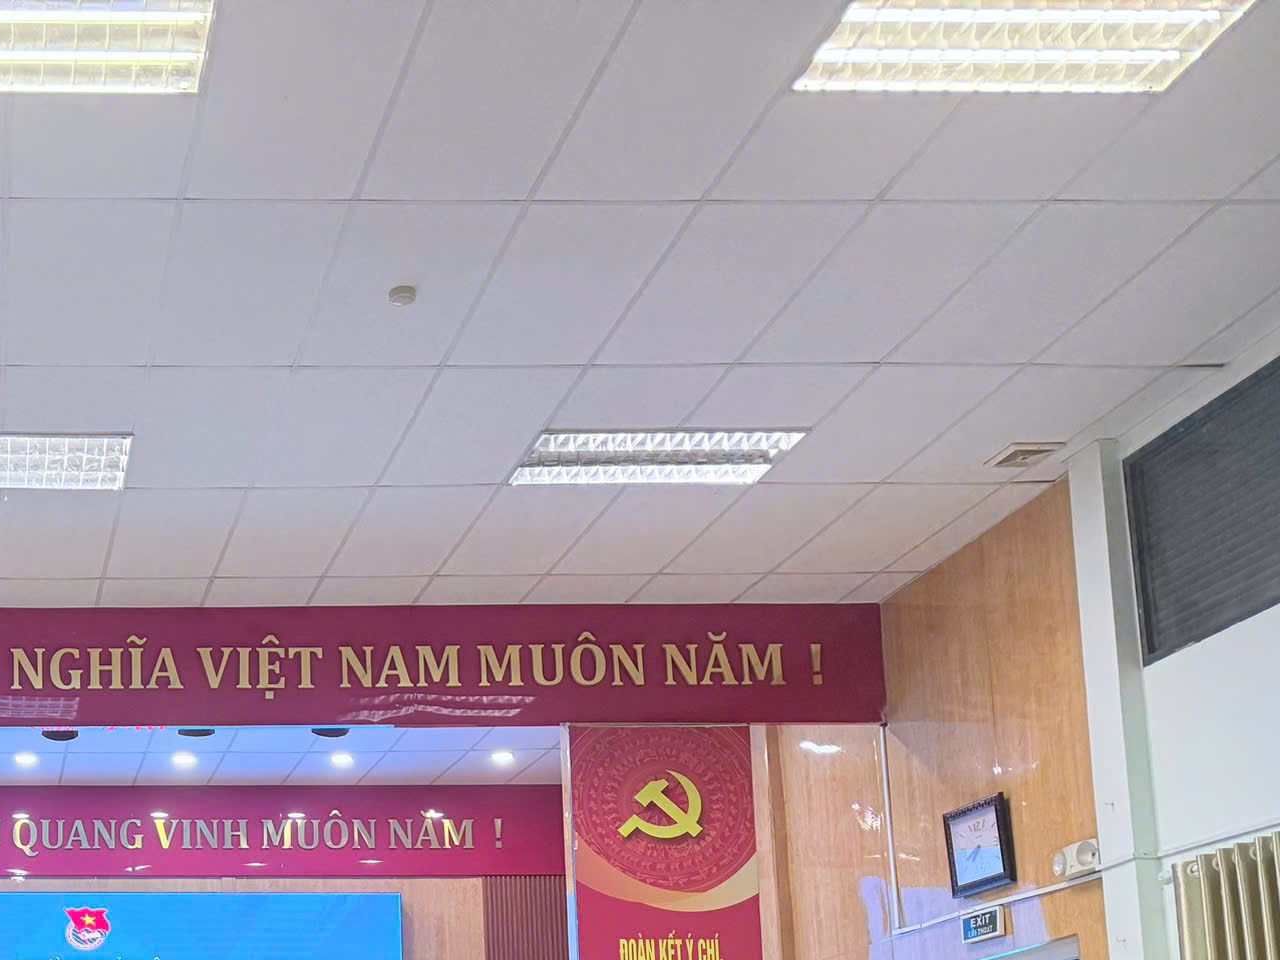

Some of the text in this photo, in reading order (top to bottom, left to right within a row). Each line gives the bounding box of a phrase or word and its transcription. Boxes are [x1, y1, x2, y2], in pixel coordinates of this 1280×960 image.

[11, 636, 184, 690] NGHĨA
[196, 634, 323, 700] VIỆT
[338, 645, 462, 688] NAM
[477, 631, 645, 687] MUÔN
[662, 631, 786, 686] NĂM
[12, 819, 143, 857] QUANG
[153, 818, 249, 849] VINH
[261, 809, 377, 849] MUÔN
[387, 809, 475, 849] NĂM
[970, 914, 990, 929] EXIT
